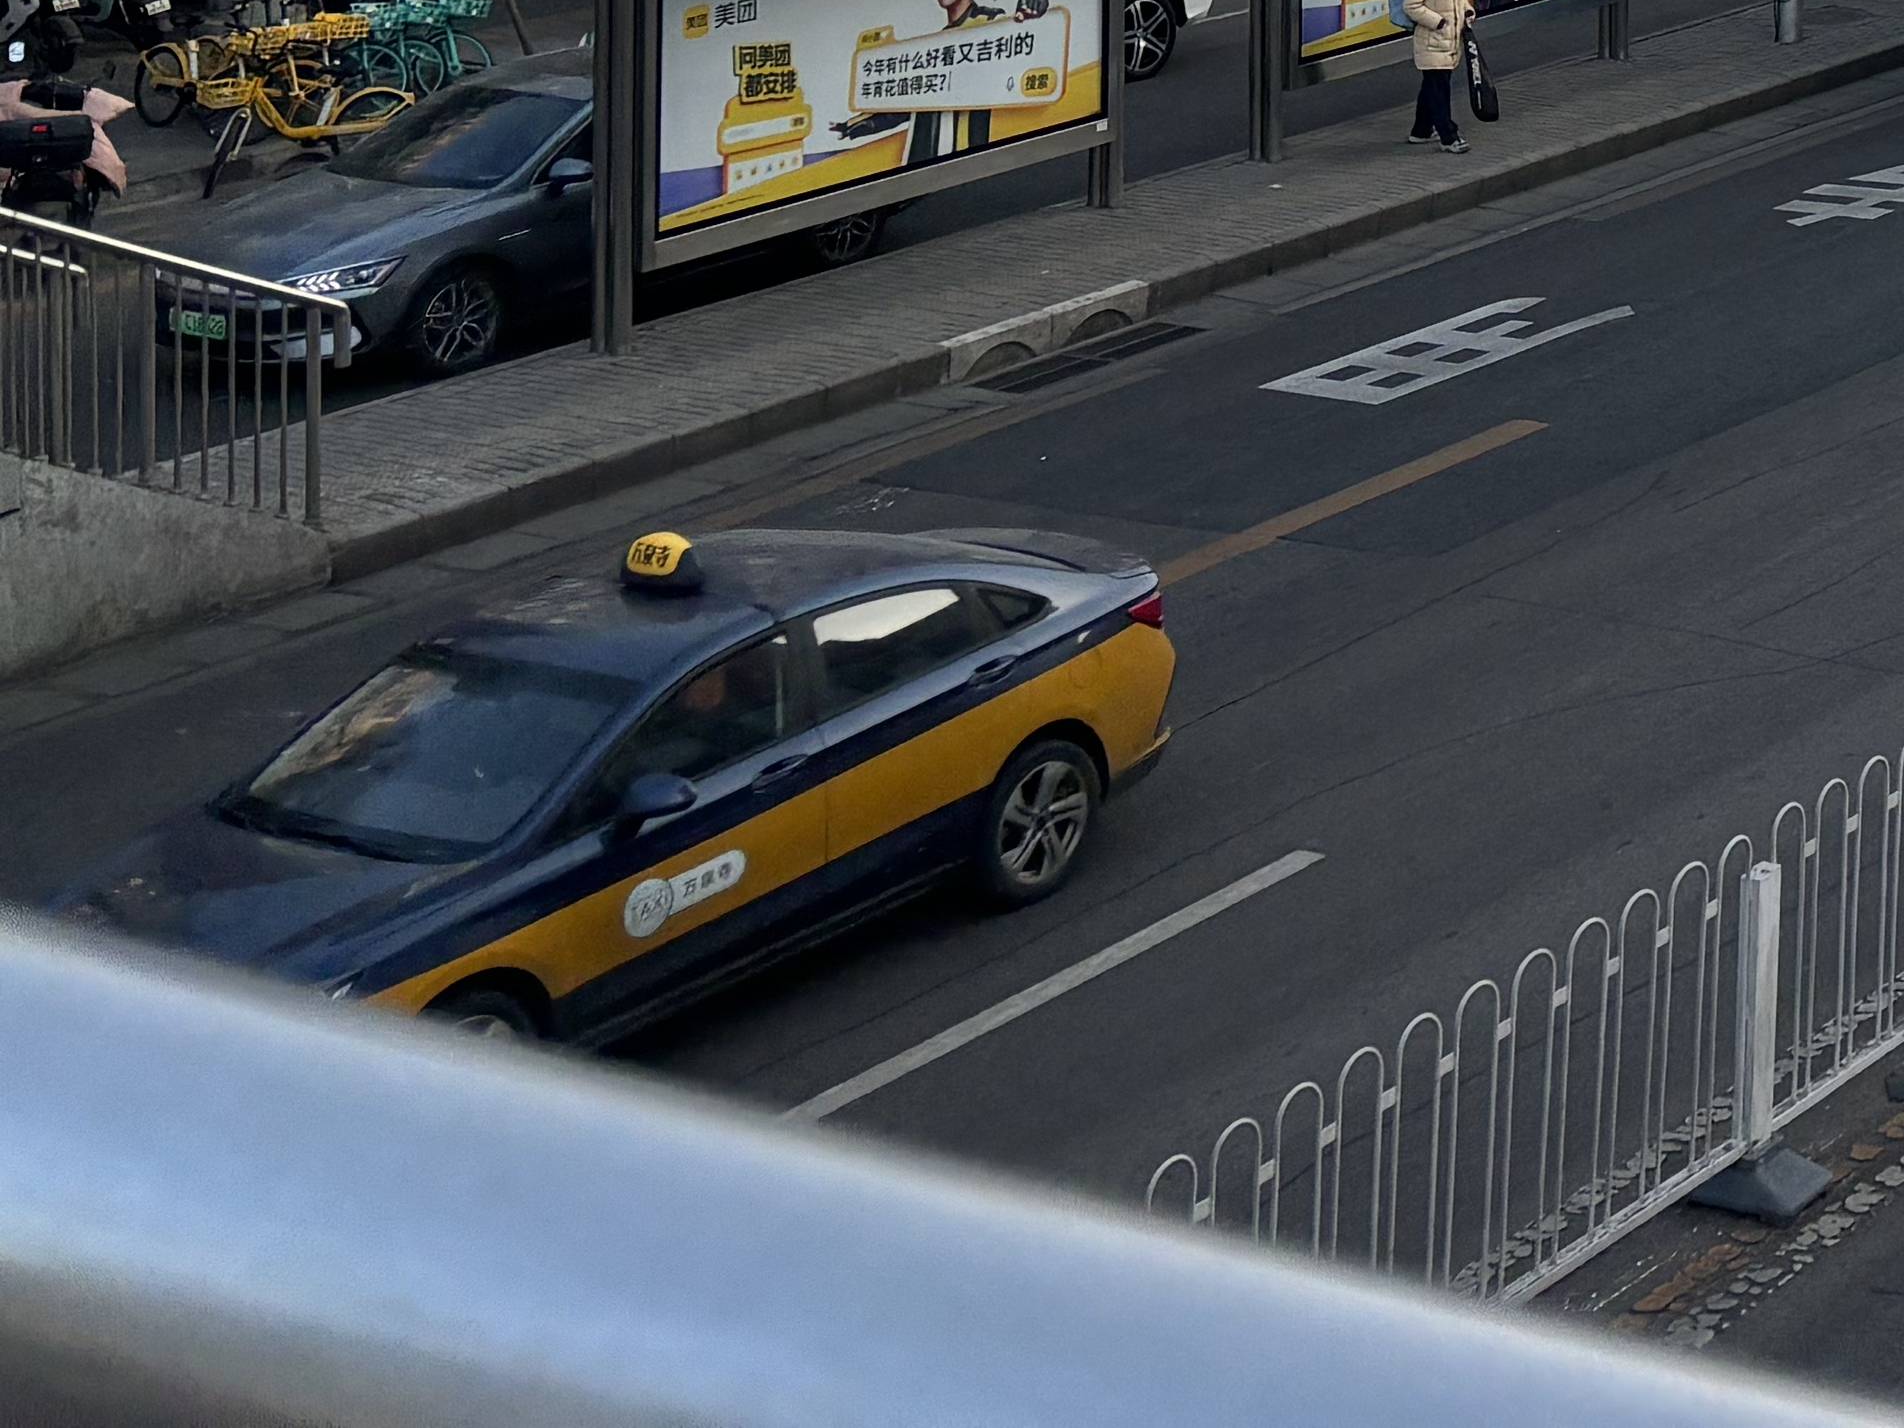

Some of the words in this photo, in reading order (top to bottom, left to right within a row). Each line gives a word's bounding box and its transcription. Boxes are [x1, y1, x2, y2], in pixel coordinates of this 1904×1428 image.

[738, 43, 792, 71] 问美团
[862, 31, 1035, 78] 今年有什么好看又吉利的
[745, 69, 798, 98] 都安排
